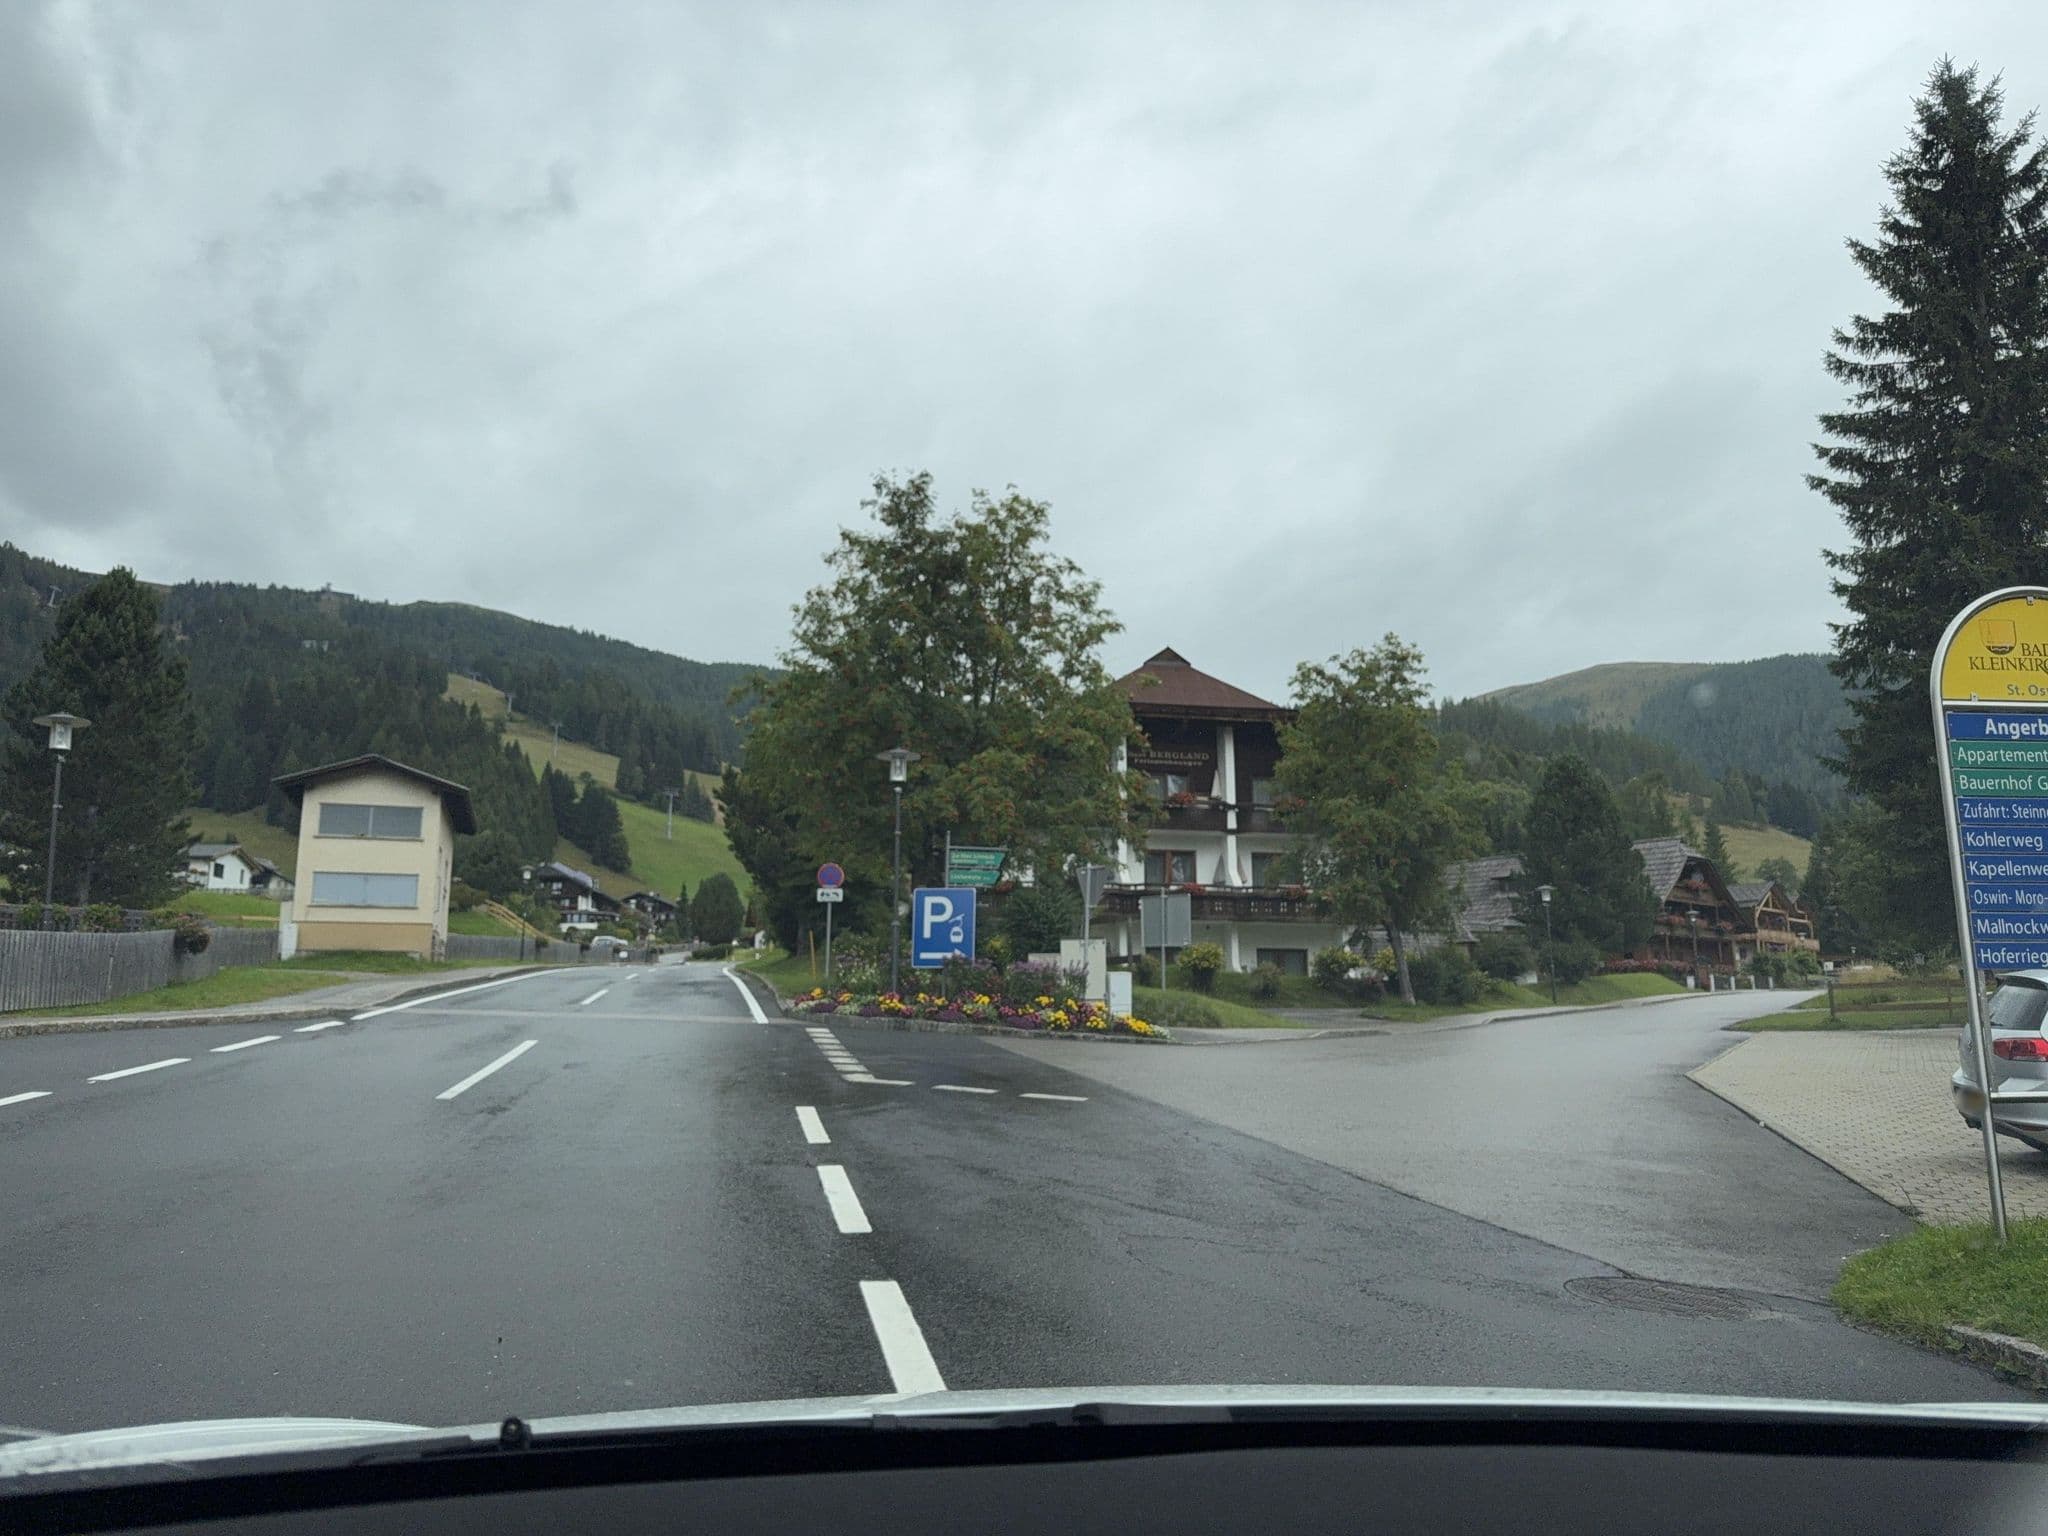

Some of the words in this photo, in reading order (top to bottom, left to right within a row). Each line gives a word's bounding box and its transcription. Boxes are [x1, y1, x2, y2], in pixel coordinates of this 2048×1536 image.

[2007, 684, 2025, 696] St.
[2028, 684, 2048, 697] Os
[1985, 718, 2048, 739] Angerb
[1957, 747, 2048, 764] Appartement
[1960, 774, 2033, 790] Bauernhof
[1963, 803, 2010, 819] Zufahrt:
[2012, 803, 2048, 818] Steinn
[1966, 831, 2043, 851] Kohlerweg
[1969, 860, 2048, 879] Kapellenwe
[1974, 889, 2013, 905] Oswin-
[2015, 889, 2048, 905] Moro-
[922, 895, 954, 939] P
[1977, 918, 2048, 935] Mallnockw
[1980, 948, 2048, 968] Hoferrieg
